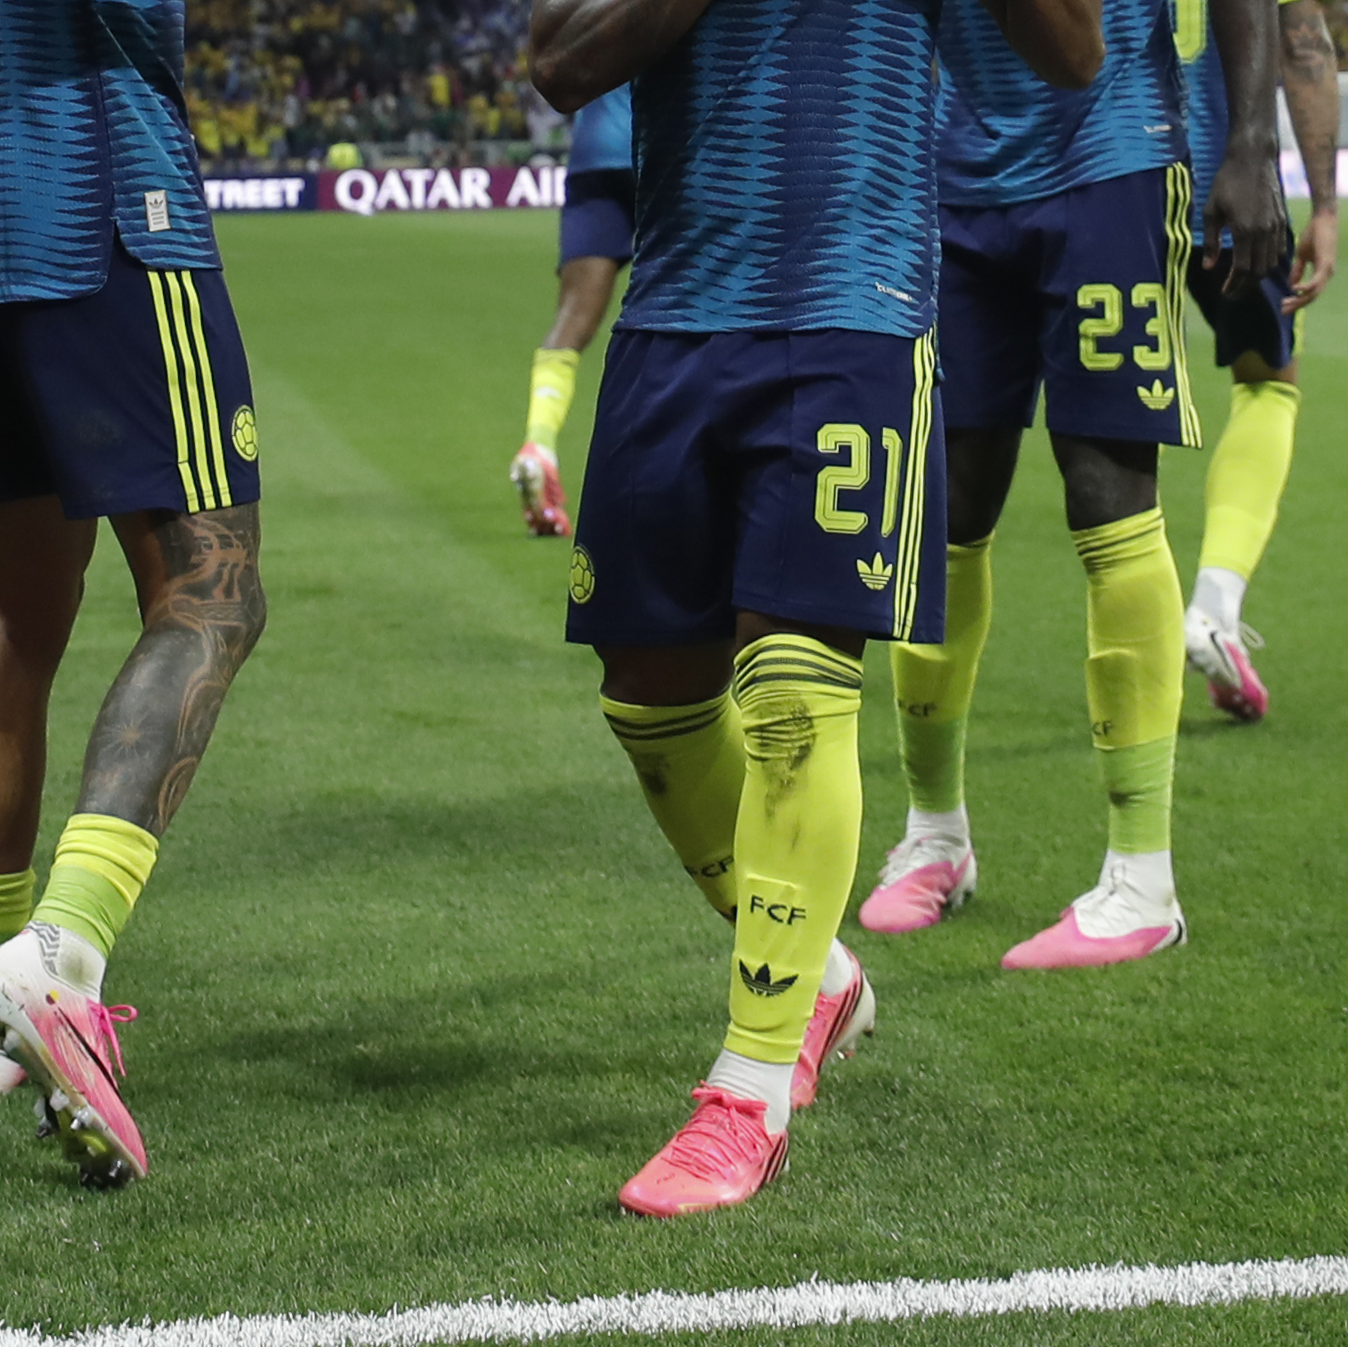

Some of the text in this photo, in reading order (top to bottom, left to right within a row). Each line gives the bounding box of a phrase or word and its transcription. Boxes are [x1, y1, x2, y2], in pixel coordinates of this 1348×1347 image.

[335, 167, 492, 215] QATAR
[1077, 282, 1173, 371] 23
[814, 423, 903, 538] 21
[750, 894, 807, 925] FCF
